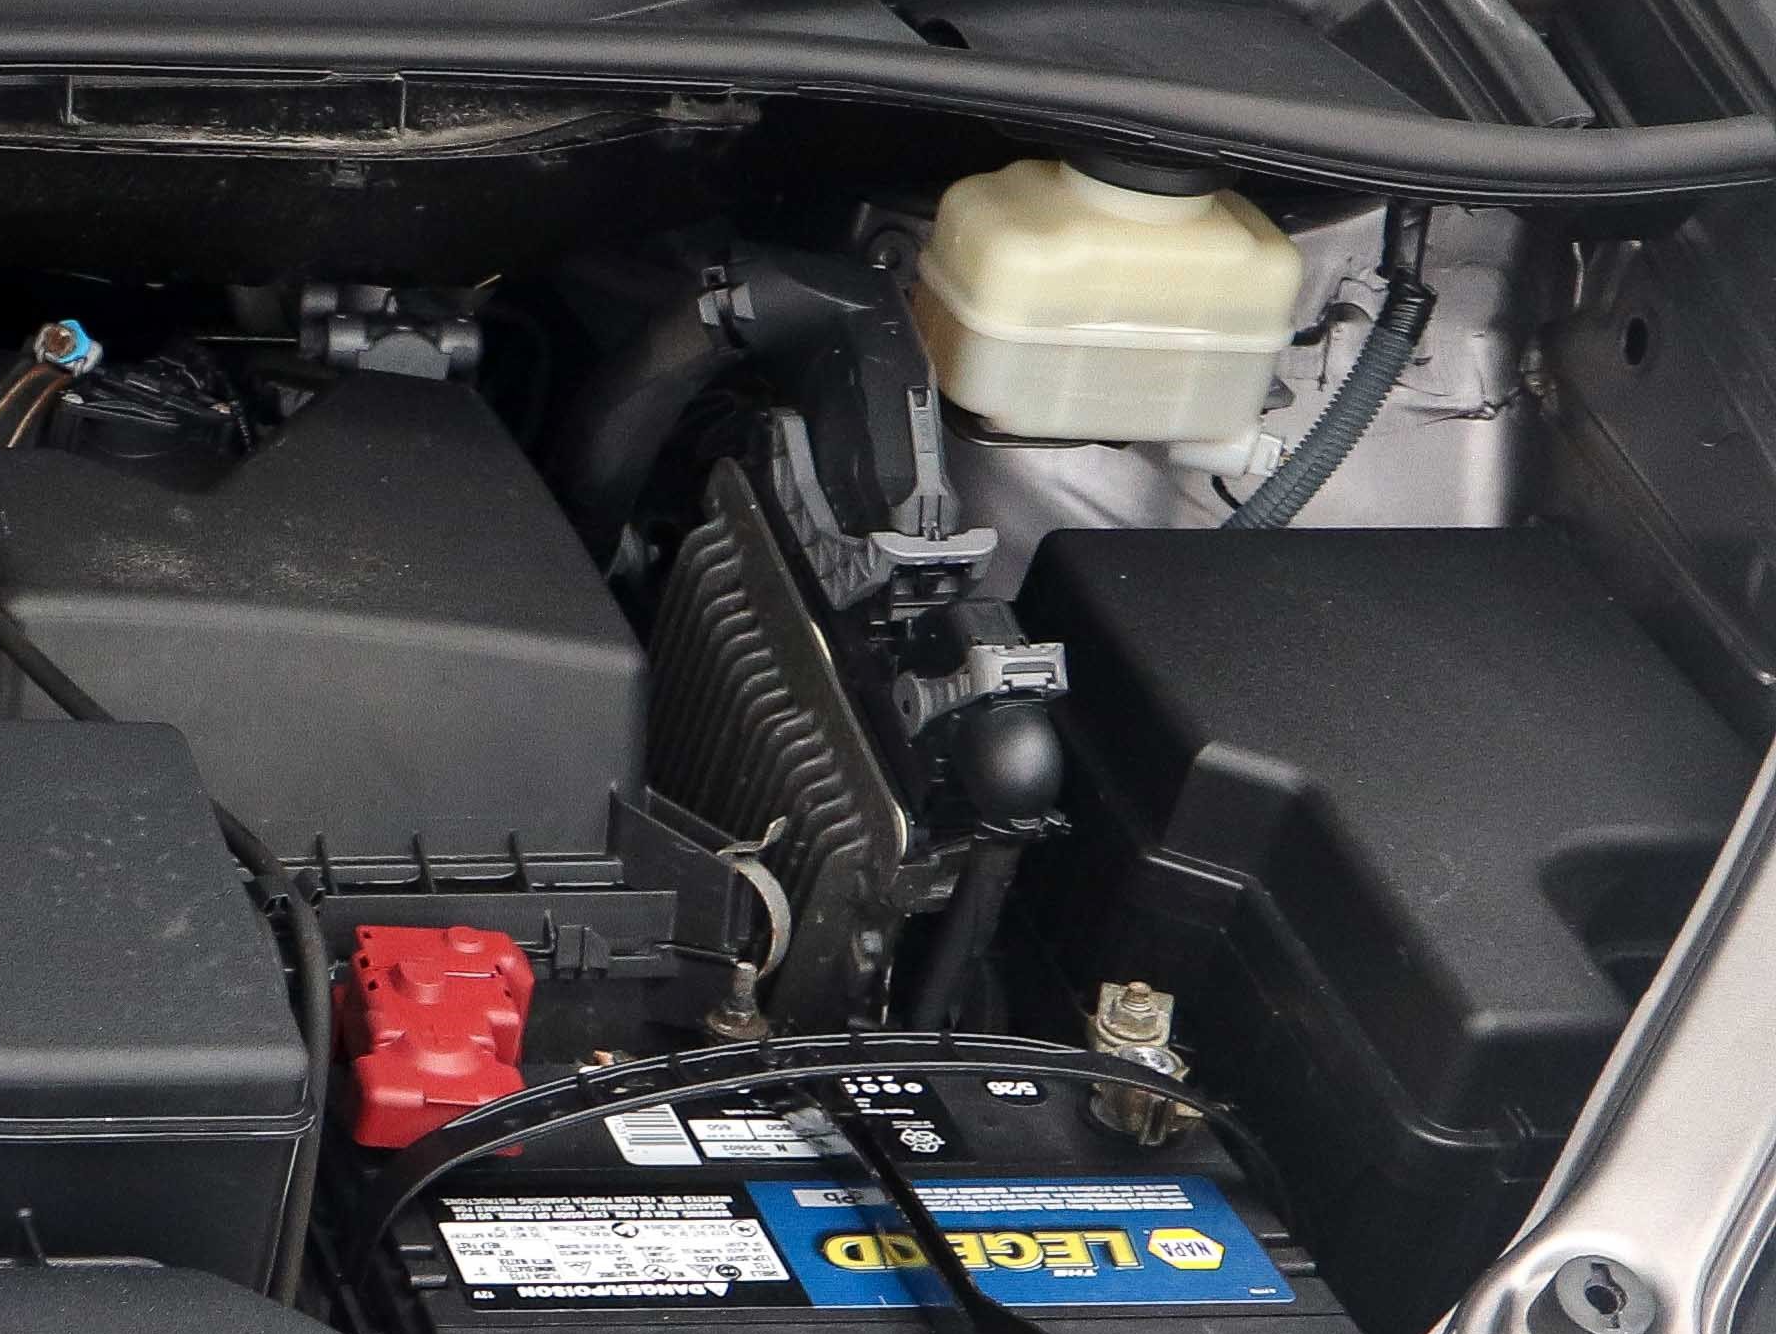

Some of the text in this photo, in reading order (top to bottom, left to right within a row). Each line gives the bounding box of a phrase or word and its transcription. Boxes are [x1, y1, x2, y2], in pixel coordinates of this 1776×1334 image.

[985, 1081, 1039, 1097] 5/26
[1158, 1240, 1212, 1256] NAPA
[517, 1283, 707, 1298] DANGER/POISON
